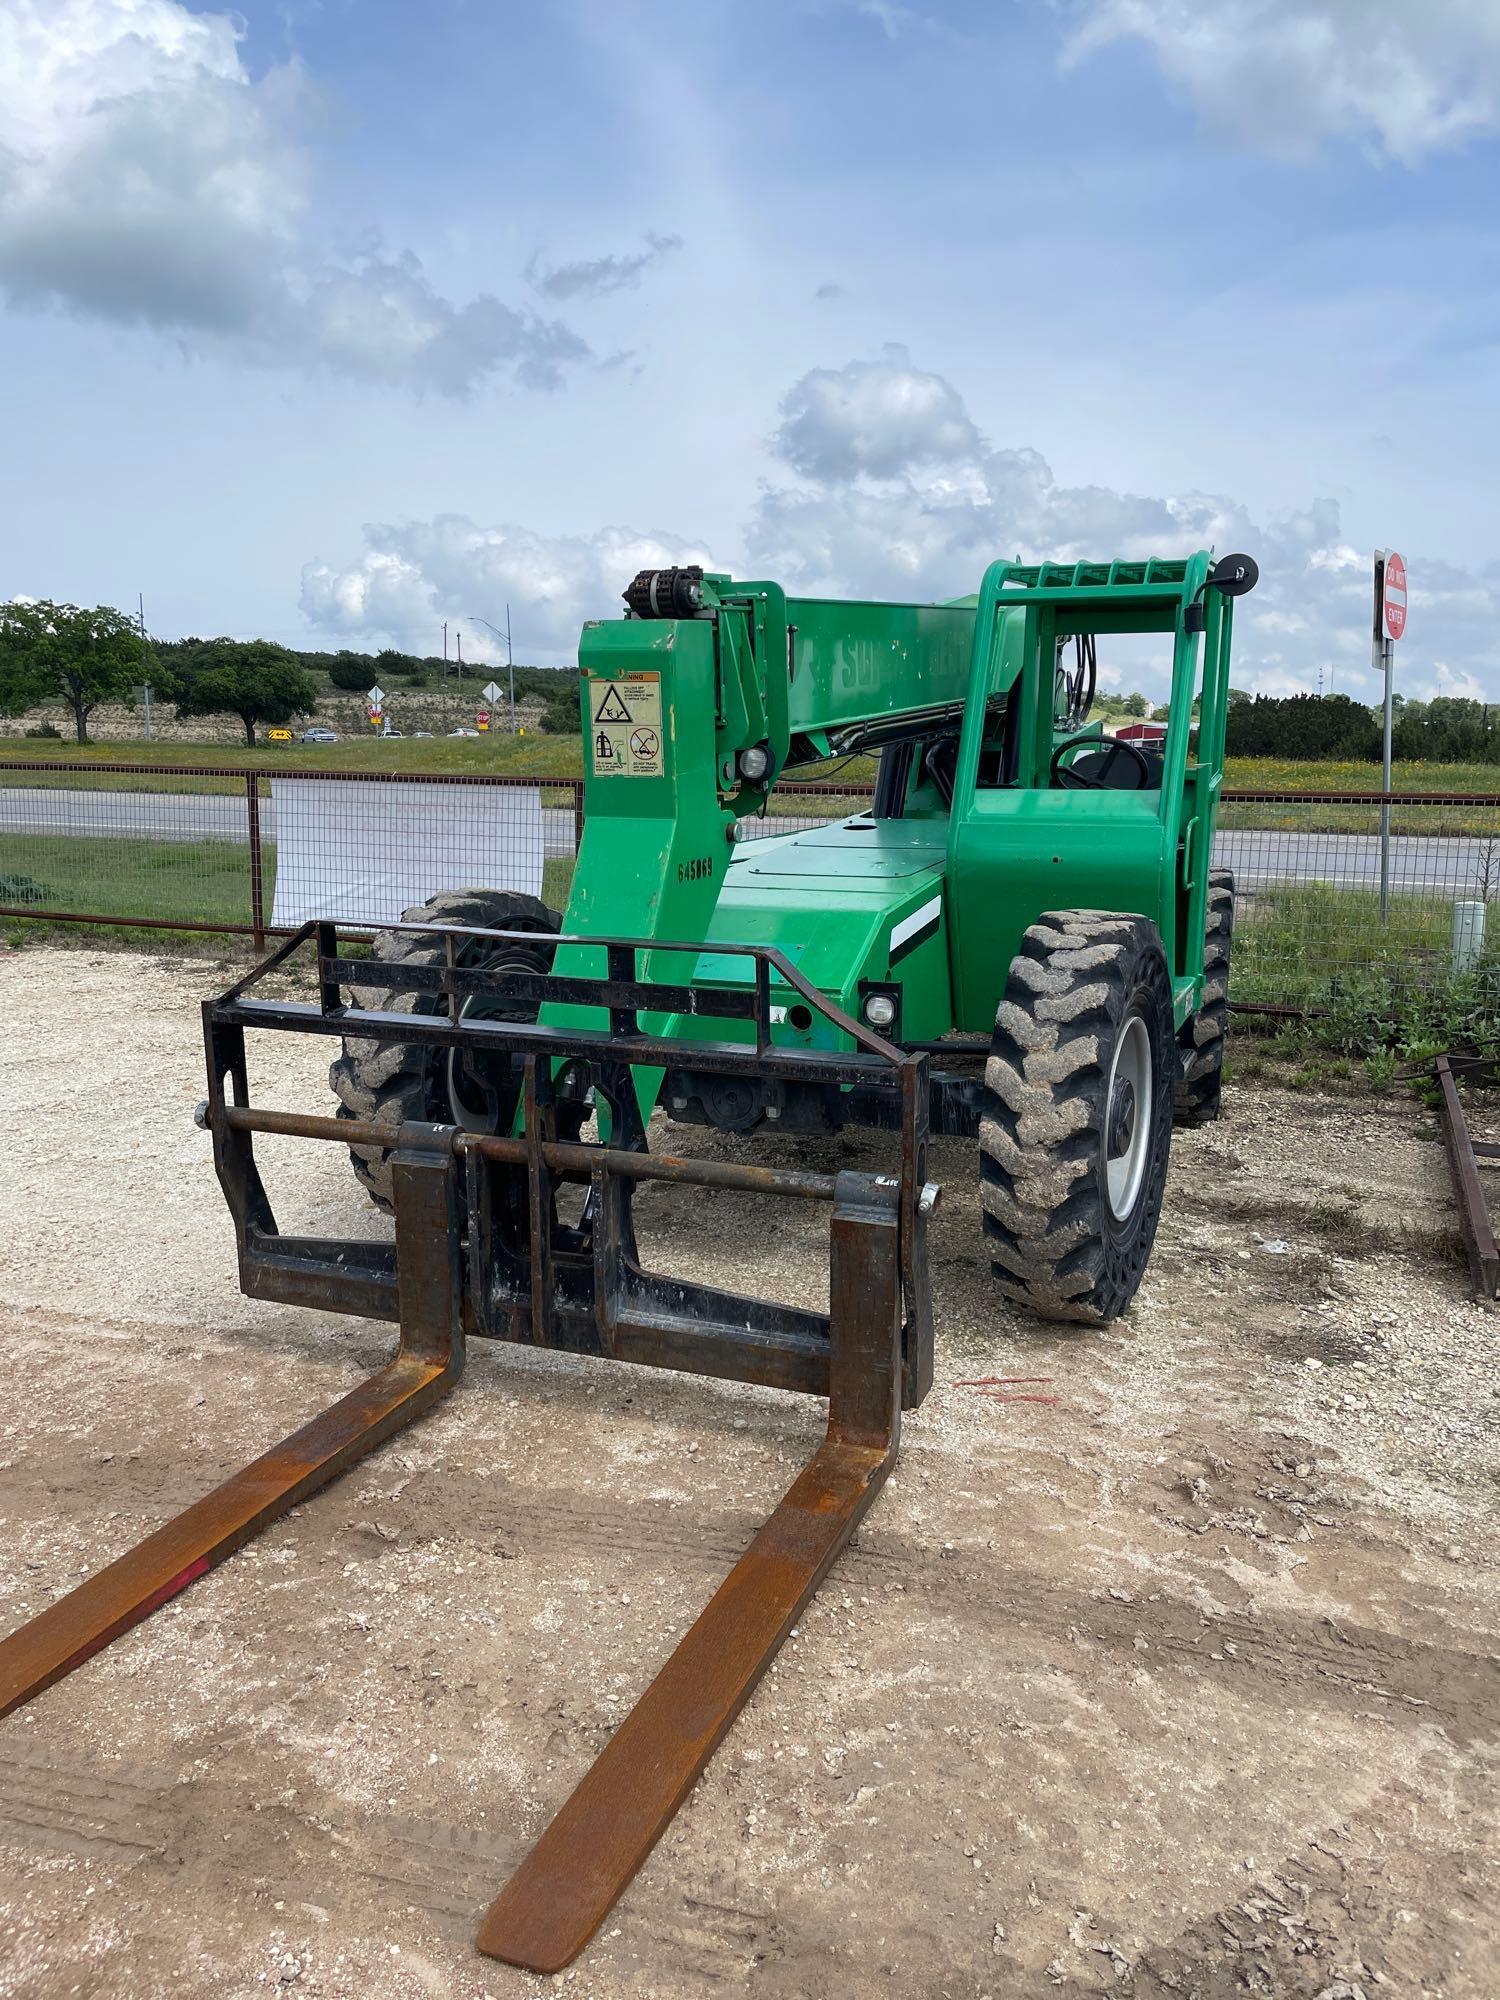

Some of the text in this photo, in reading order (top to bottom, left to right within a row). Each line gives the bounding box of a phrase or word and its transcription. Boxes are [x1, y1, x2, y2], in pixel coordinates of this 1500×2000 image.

[1387, 566, 1405, 585] DO NOT
[1389, 608, 1403, 625] ENTER
[678, 857, 713, 883] 645869
